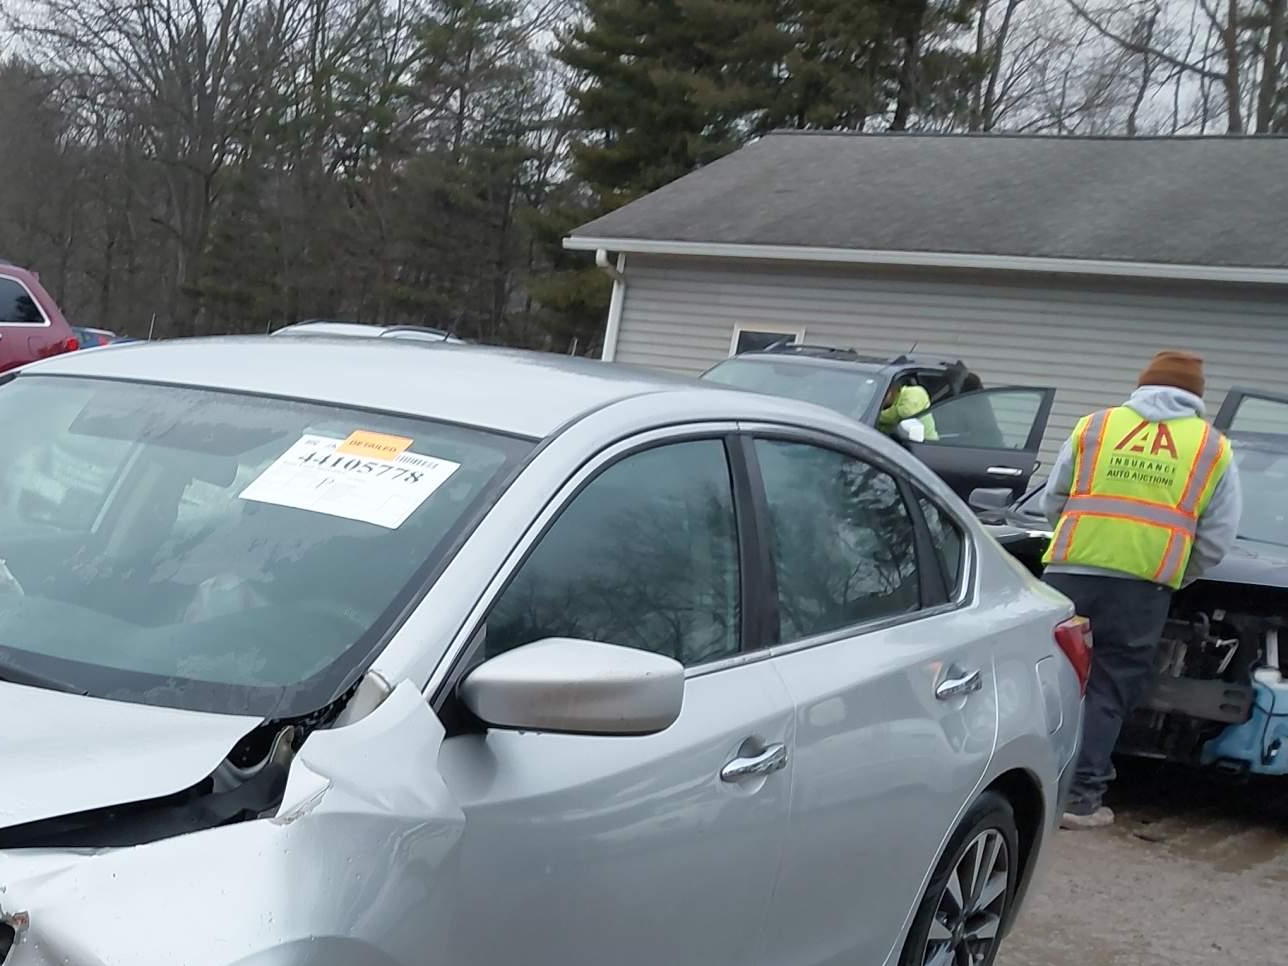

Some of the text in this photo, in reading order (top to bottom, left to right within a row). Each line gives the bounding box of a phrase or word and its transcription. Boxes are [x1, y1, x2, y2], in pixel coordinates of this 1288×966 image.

[298, 451, 424, 483] 44105778
[1110, 457, 1176, 474] INSURANCE
[1106, 469, 1174, 486] AUTO AUCTIONS
